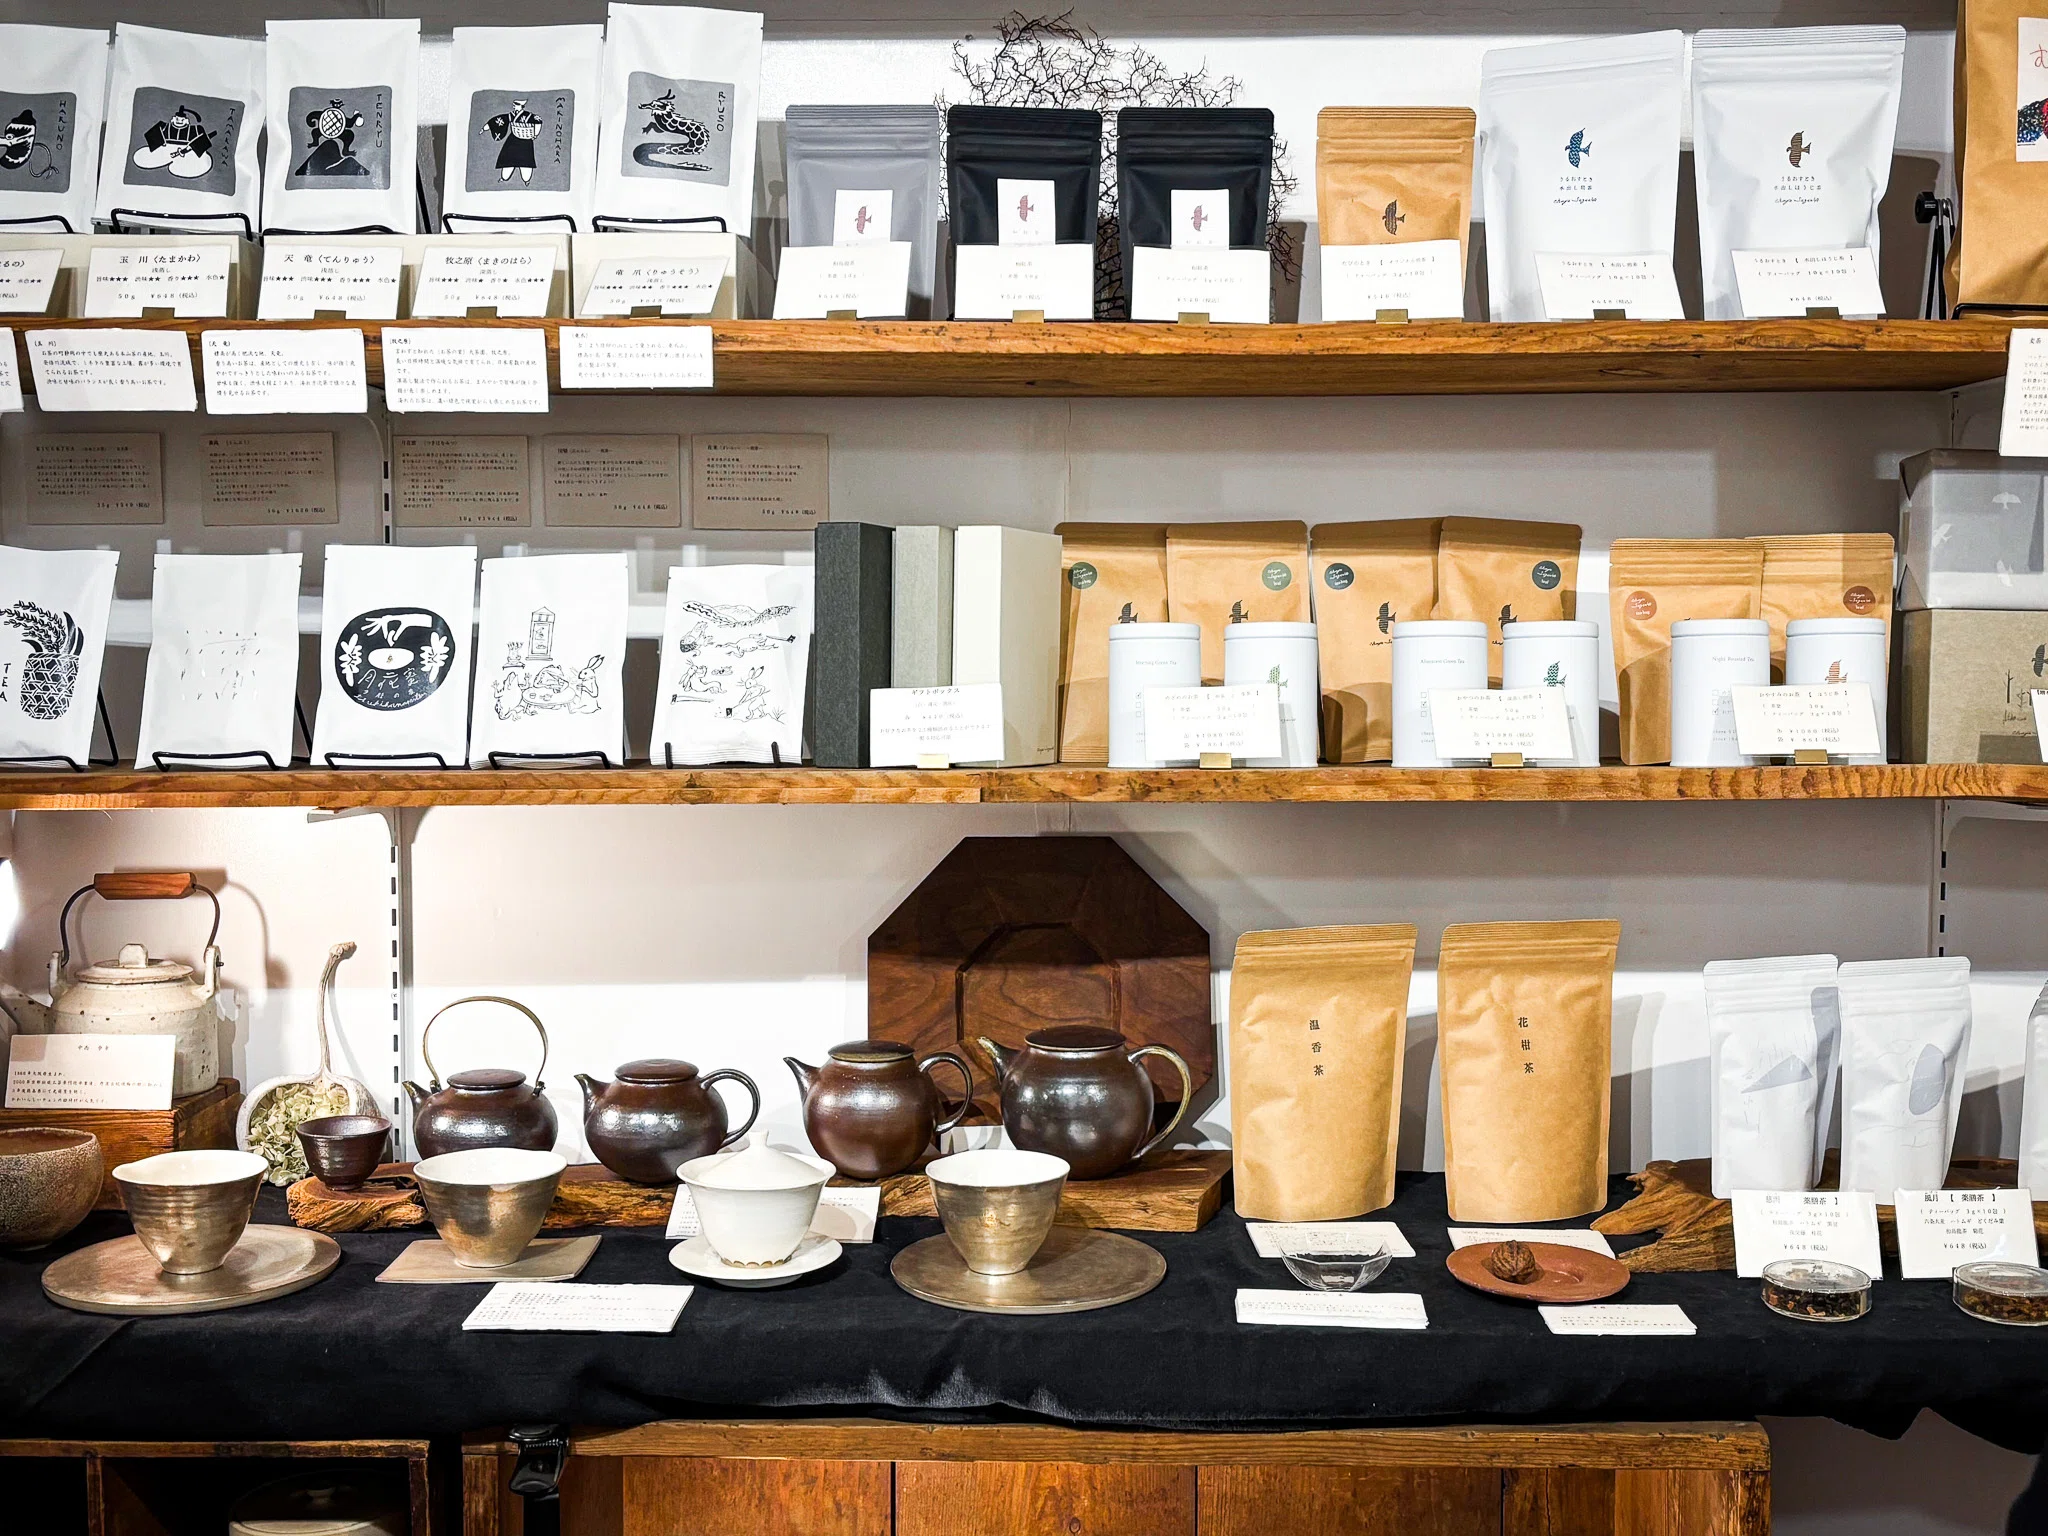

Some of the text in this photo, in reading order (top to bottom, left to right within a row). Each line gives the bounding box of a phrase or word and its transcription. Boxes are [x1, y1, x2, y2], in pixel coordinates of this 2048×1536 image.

[57, 100, 67, 151] HARUNO
[553, 97, 567, 164] MAKINOHARA
[717, 91, 726, 132] RYUSO
[284, 254, 294, 263] 天
[0, 663, 12, 702] TEA
[1308, 1019, 1324, 1076] 温香茶
[1517, 1017, 1535, 1075] 花柑茶
